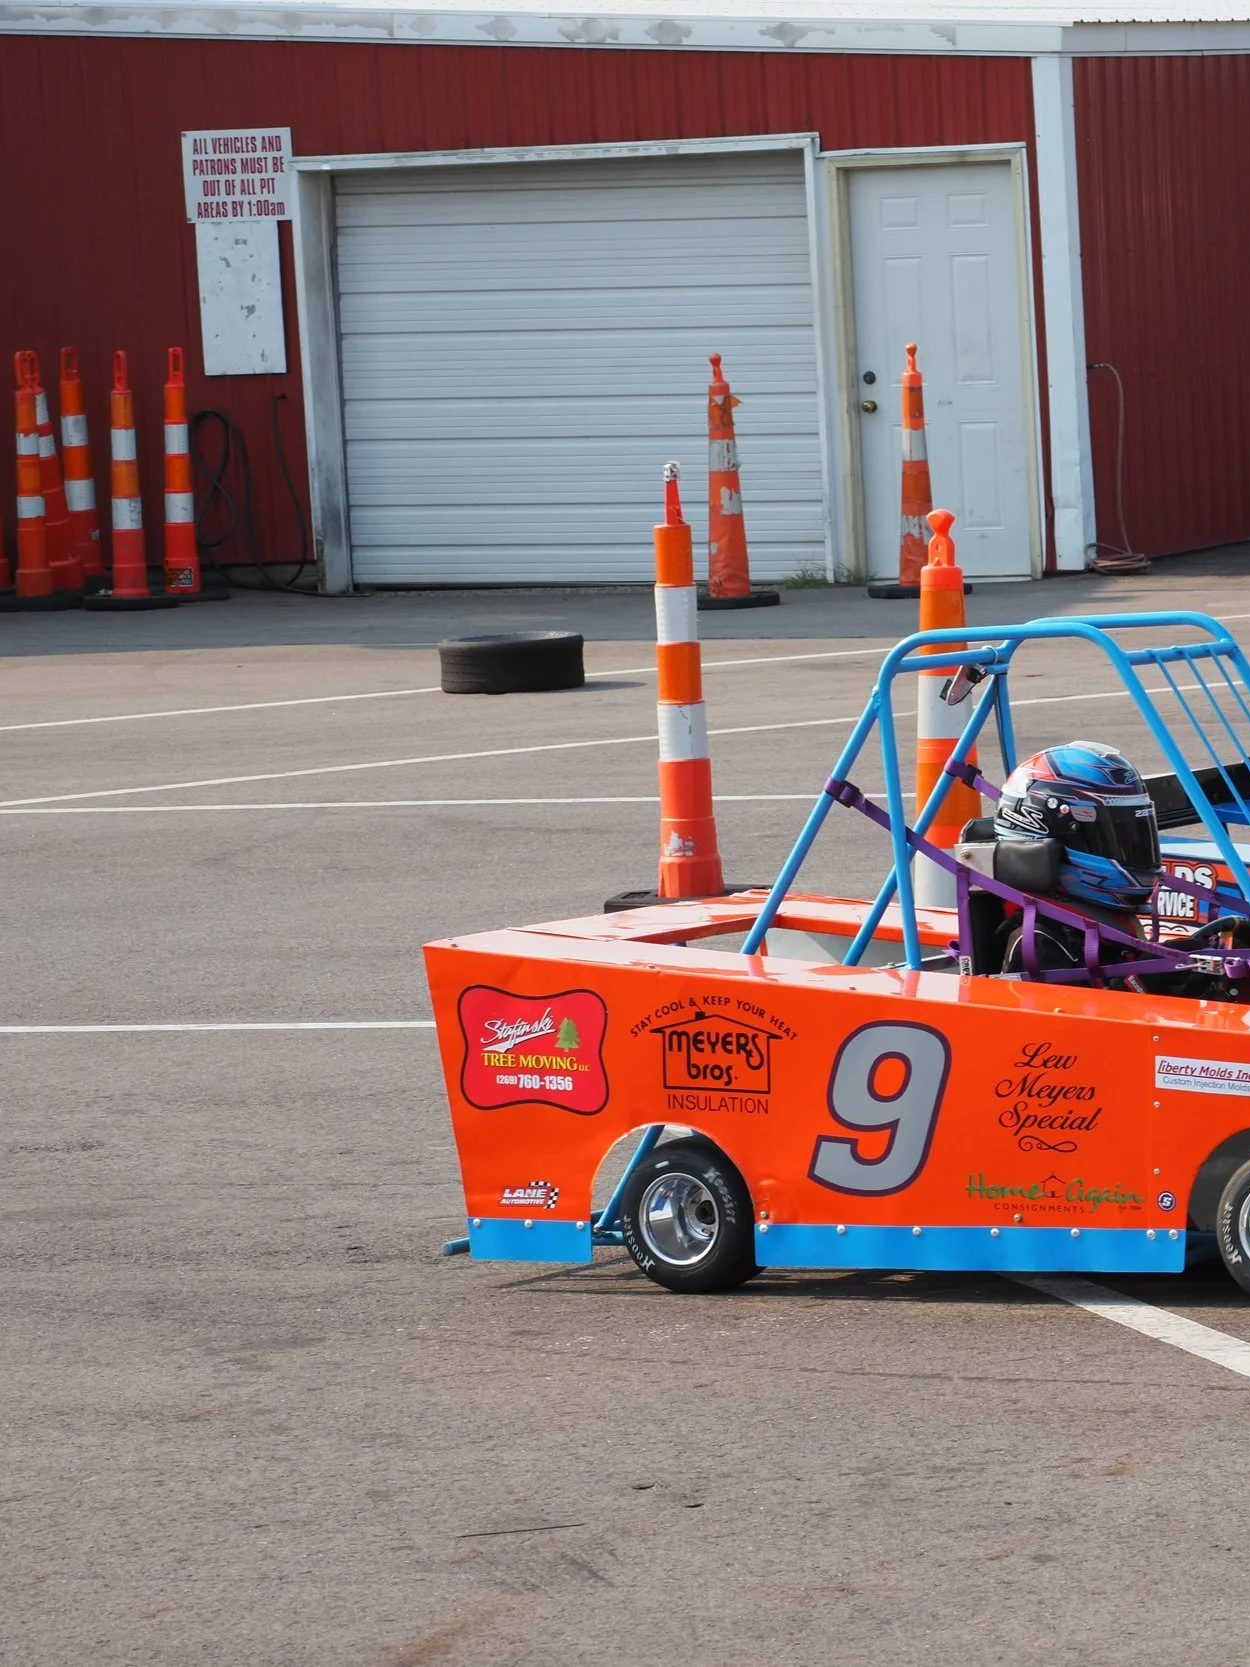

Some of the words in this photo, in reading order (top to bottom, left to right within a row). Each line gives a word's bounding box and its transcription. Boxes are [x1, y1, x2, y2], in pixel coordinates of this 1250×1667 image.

[193, 138, 208, 155] ALL
[211, 136, 257, 154] VEHICLES
[261, 135, 282, 152] AND
[192, 158, 237, 176] PATRONS
[240, 157, 268, 174] MUST
[272, 156, 285, 173] BE
[203, 180, 221, 196] OUT
[224, 179, 236, 196] OF
[240, 179, 256, 195] ALL
[260, 178, 276, 195] PIT
[197, 201, 228, 218] AREAS
[231, 200, 244, 217] BY
[248, 200, 285, 217] 1:00am
[1157, 891, 1195, 917] RVICE
[630, 1014, 653, 1038] STAY
[655, 1000, 685, 1019] COOL
[689, 997, 697, 1007] &
[703, 995, 731, 1006] KEEP
[736, 1000, 766, 1018] YOUR
[769, 1016, 798, 1041] HEAT
[481, 1052, 517, 1068] TREE
[519, 1054, 578, 1072] MOVING
[1014, 1042, 1077, 1069] Lew
[1158, 1060, 1197, 1075] Liberty
[1199, 1066, 1234, 1079] Molds
[496, 1075, 518, 1085] (269)
[518, 1074, 573, 1091] 760-1356
[995, 1072, 1095, 1108] Meyers
[1163, 1076, 1192, 1086] Custom
[1194, 1079, 1225, 1090] Injection
[1228, 1083, 1250, 1092] Molds
[667, 1094, 769, 1114] INSULATION
[807, 1019, 952, 1197] 9
[999, 1101, 1102, 1136] Special
[503, 1188, 547, 1198] LANE
[965, 1171, 1045, 1200] Home
[1066, 1178, 1146, 1214] Again
[994, 1202, 1085, 1213] CONSIGNMENTS
